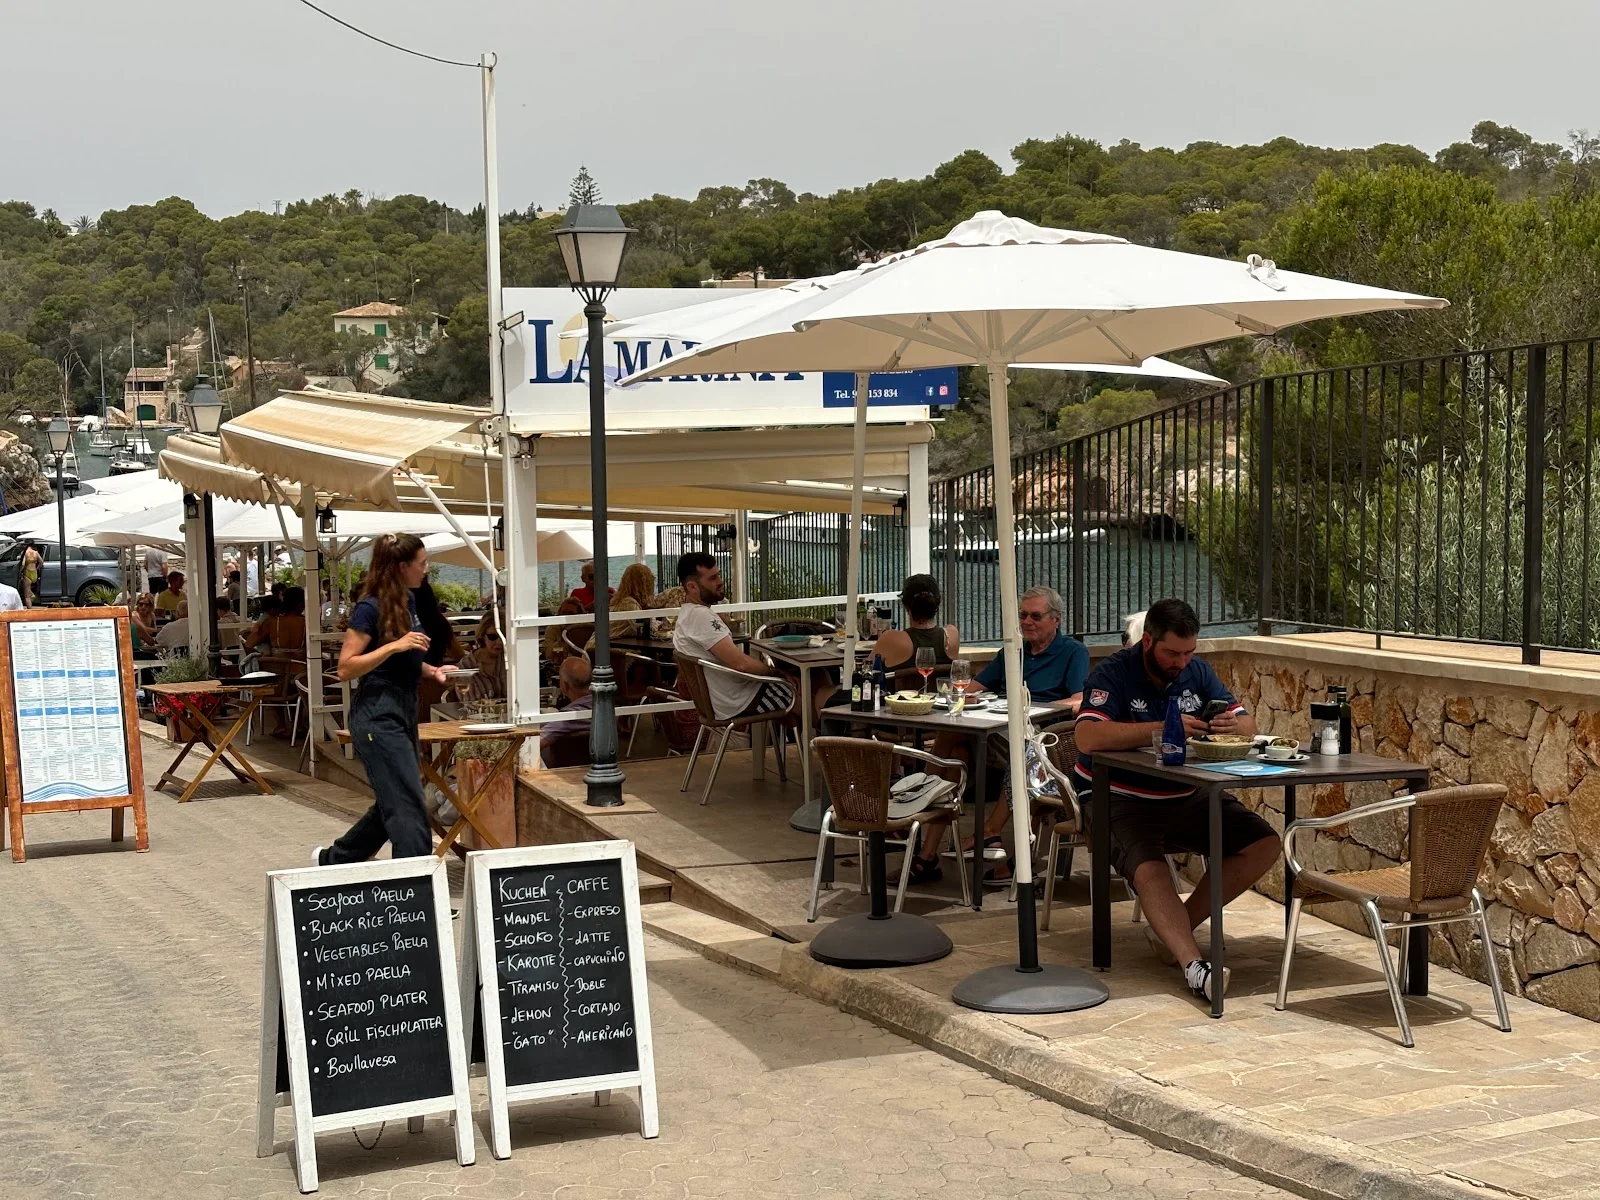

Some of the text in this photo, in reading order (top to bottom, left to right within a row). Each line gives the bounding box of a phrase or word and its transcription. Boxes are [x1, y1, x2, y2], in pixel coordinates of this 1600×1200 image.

[834, 390, 850, 399] Tel.
[869, 389, 882, 398] 153
[884, 388, 898, 398] 834
[499, 874, 555, 902] KUCHEN
[567, 876, 610, 894] CAFFE
[308, 886, 415, 915] Seafood PAELLA
[309, 920, 354, 942] BLACK
[385, 905, 426, 924] PAELLA
[504, 911, 551, 927] MANDEL
[314, 932, 428, 963] VEGETABLES PAELLA
[504, 931, 553, 948] SCHOKO
[507, 953, 556, 972] KAROTTE
[366, 964, 411, 982] PAELLA
[574, 977, 607, 994] DOBLE
[317, 990, 428, 1021] SEAFOOD PLATER
[578, 1002, 621, 1016] CORTADO
[327, 1054, 397, 1078] Boullavesa
